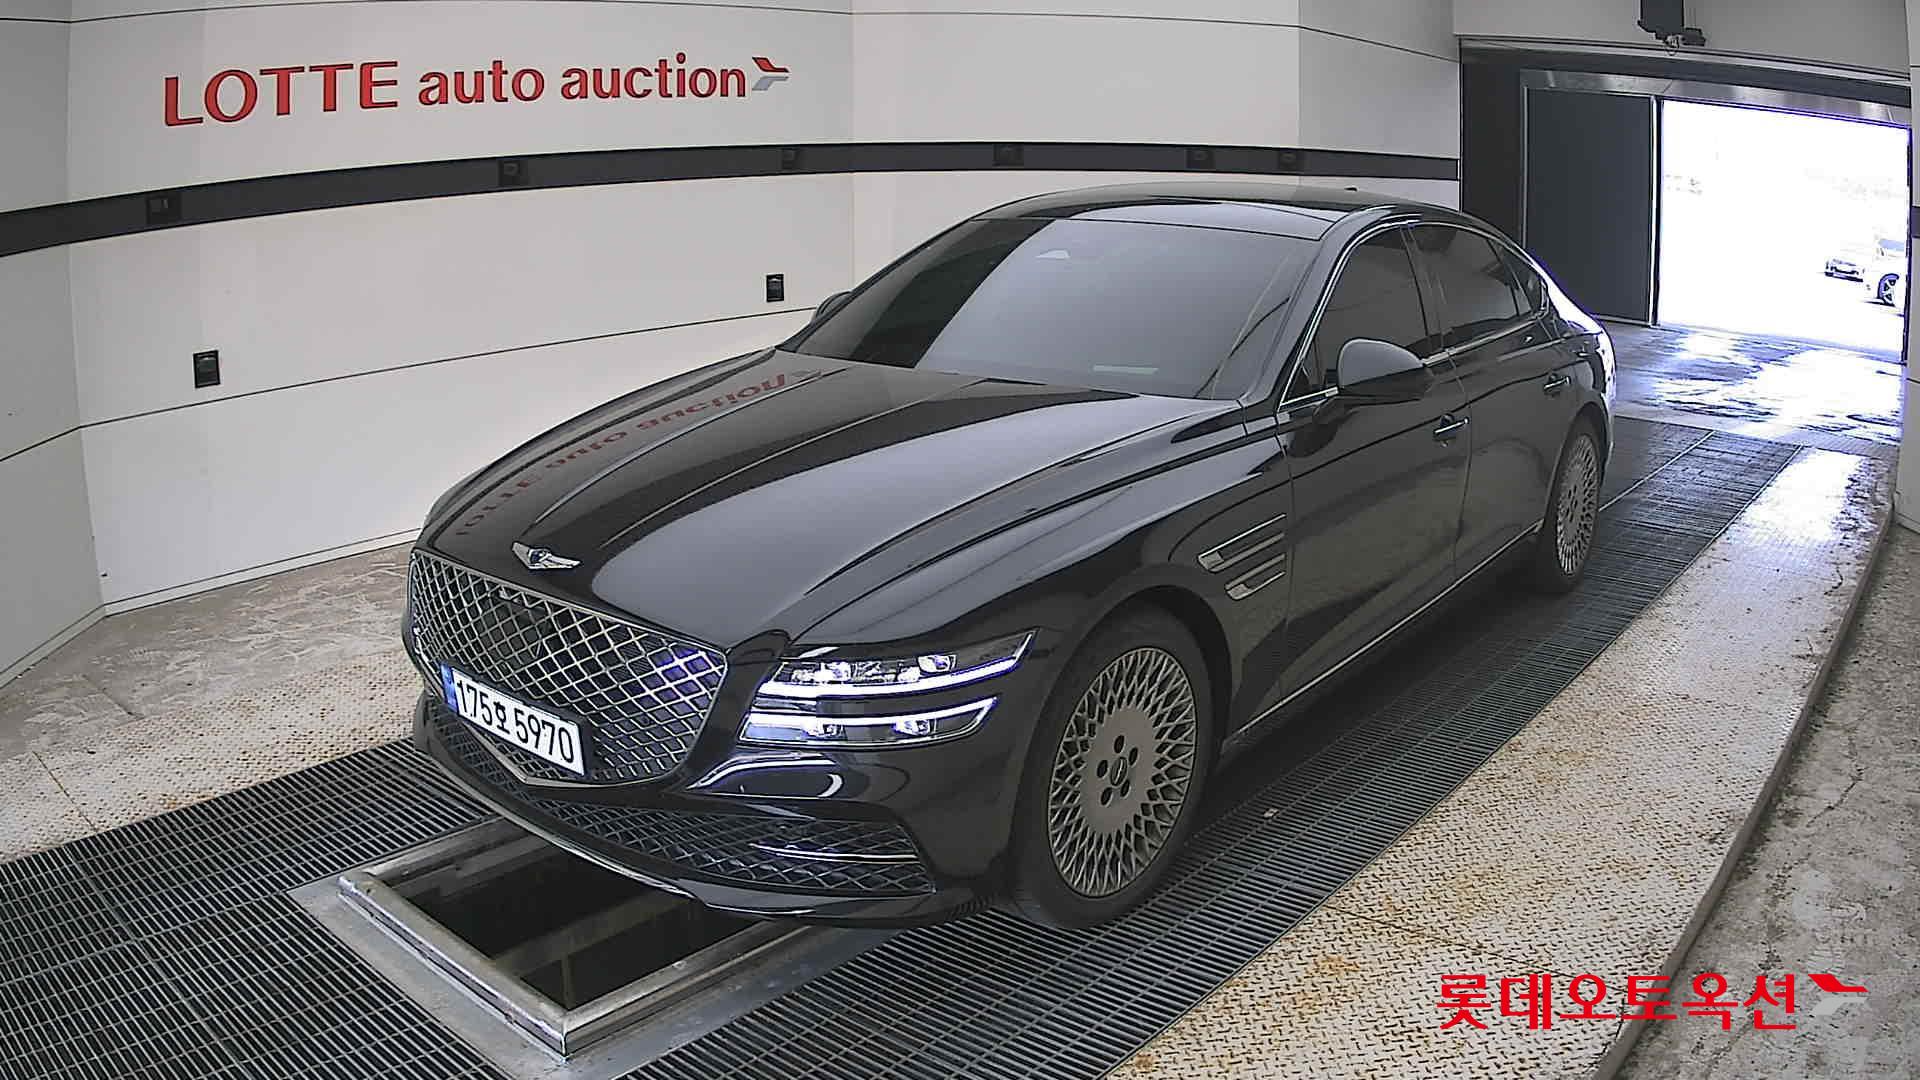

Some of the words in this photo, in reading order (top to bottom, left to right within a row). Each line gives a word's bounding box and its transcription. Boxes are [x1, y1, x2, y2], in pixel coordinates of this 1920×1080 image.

[164, 60, 398, 127] LOTTE
[419, 60, 545, 105] auto
[561, 52, 746, 99] auction
[514, 708, 574, 763] 5970
